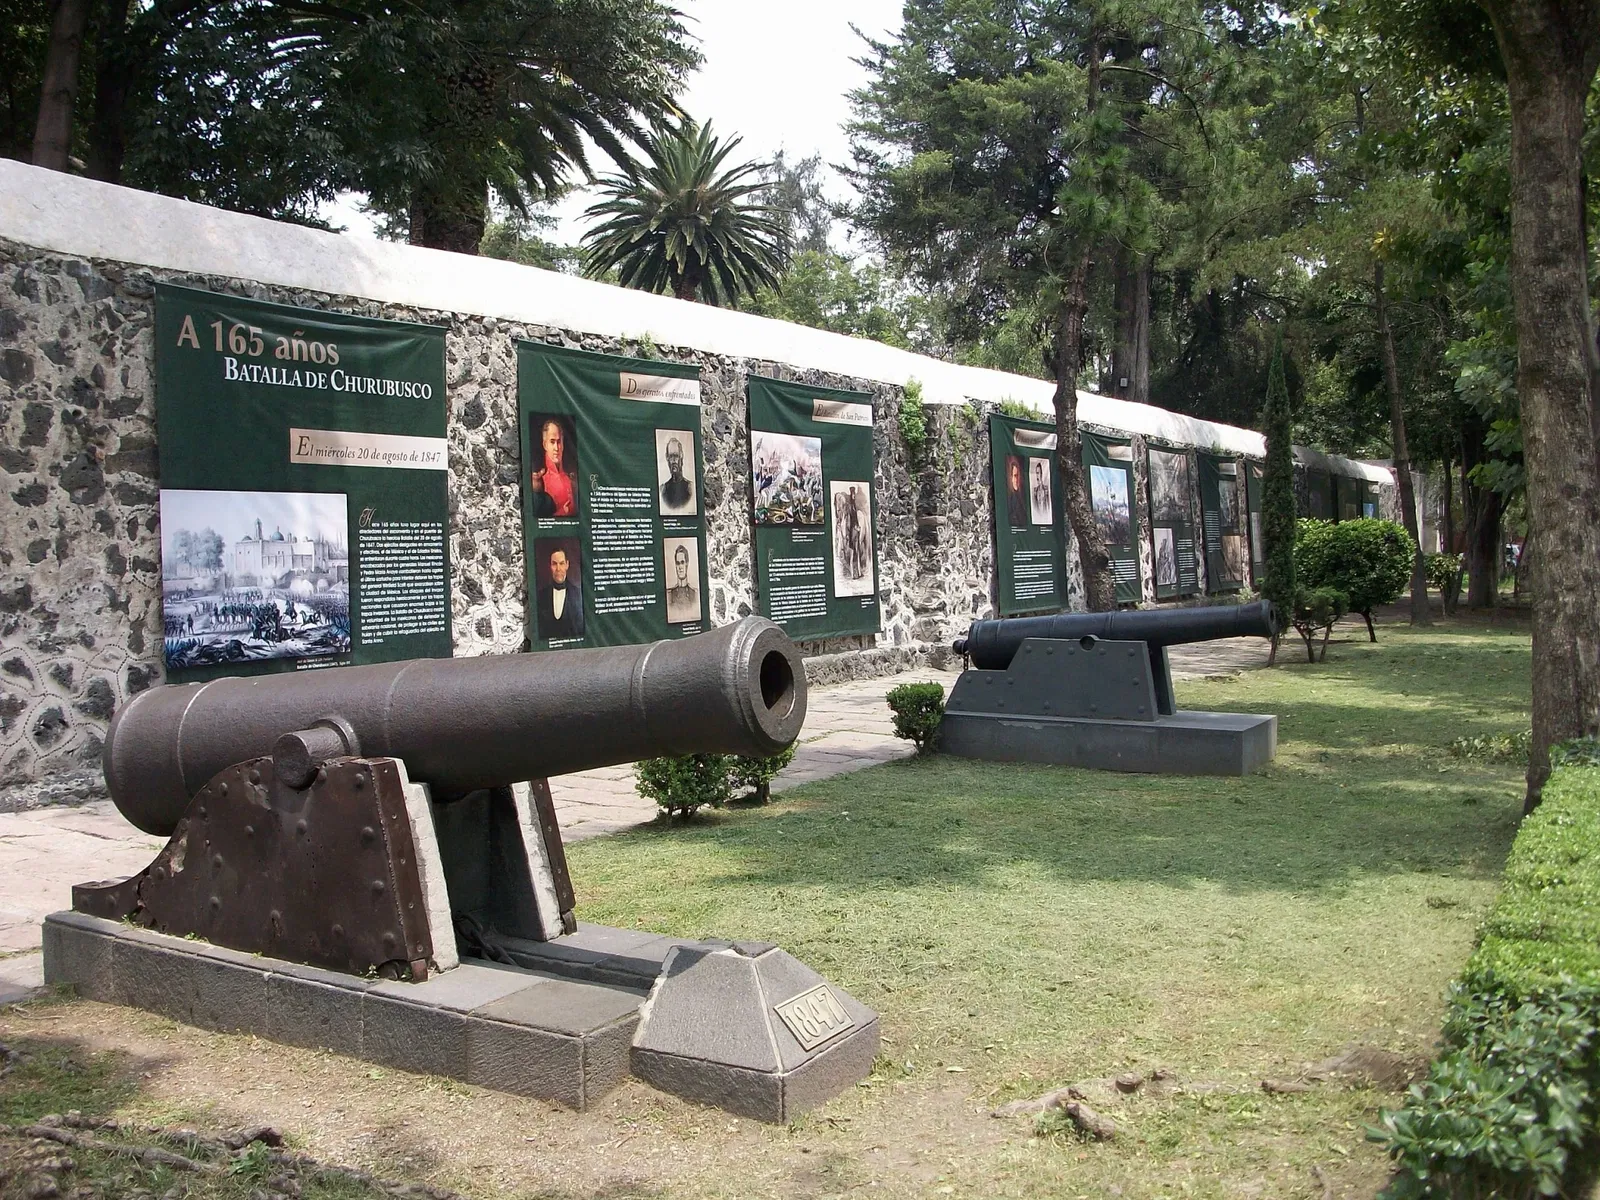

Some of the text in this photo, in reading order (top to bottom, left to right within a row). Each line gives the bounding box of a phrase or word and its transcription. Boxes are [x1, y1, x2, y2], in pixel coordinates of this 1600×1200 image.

[177, 315, 339, 365] A 165 años
[224, 357, 432, 399] BATALLA DE CHURUBUSCO
[295, 435, 441, 464] El miércoles 20 de agosto de 1847
[784, 993, 845, 1043] 1847
